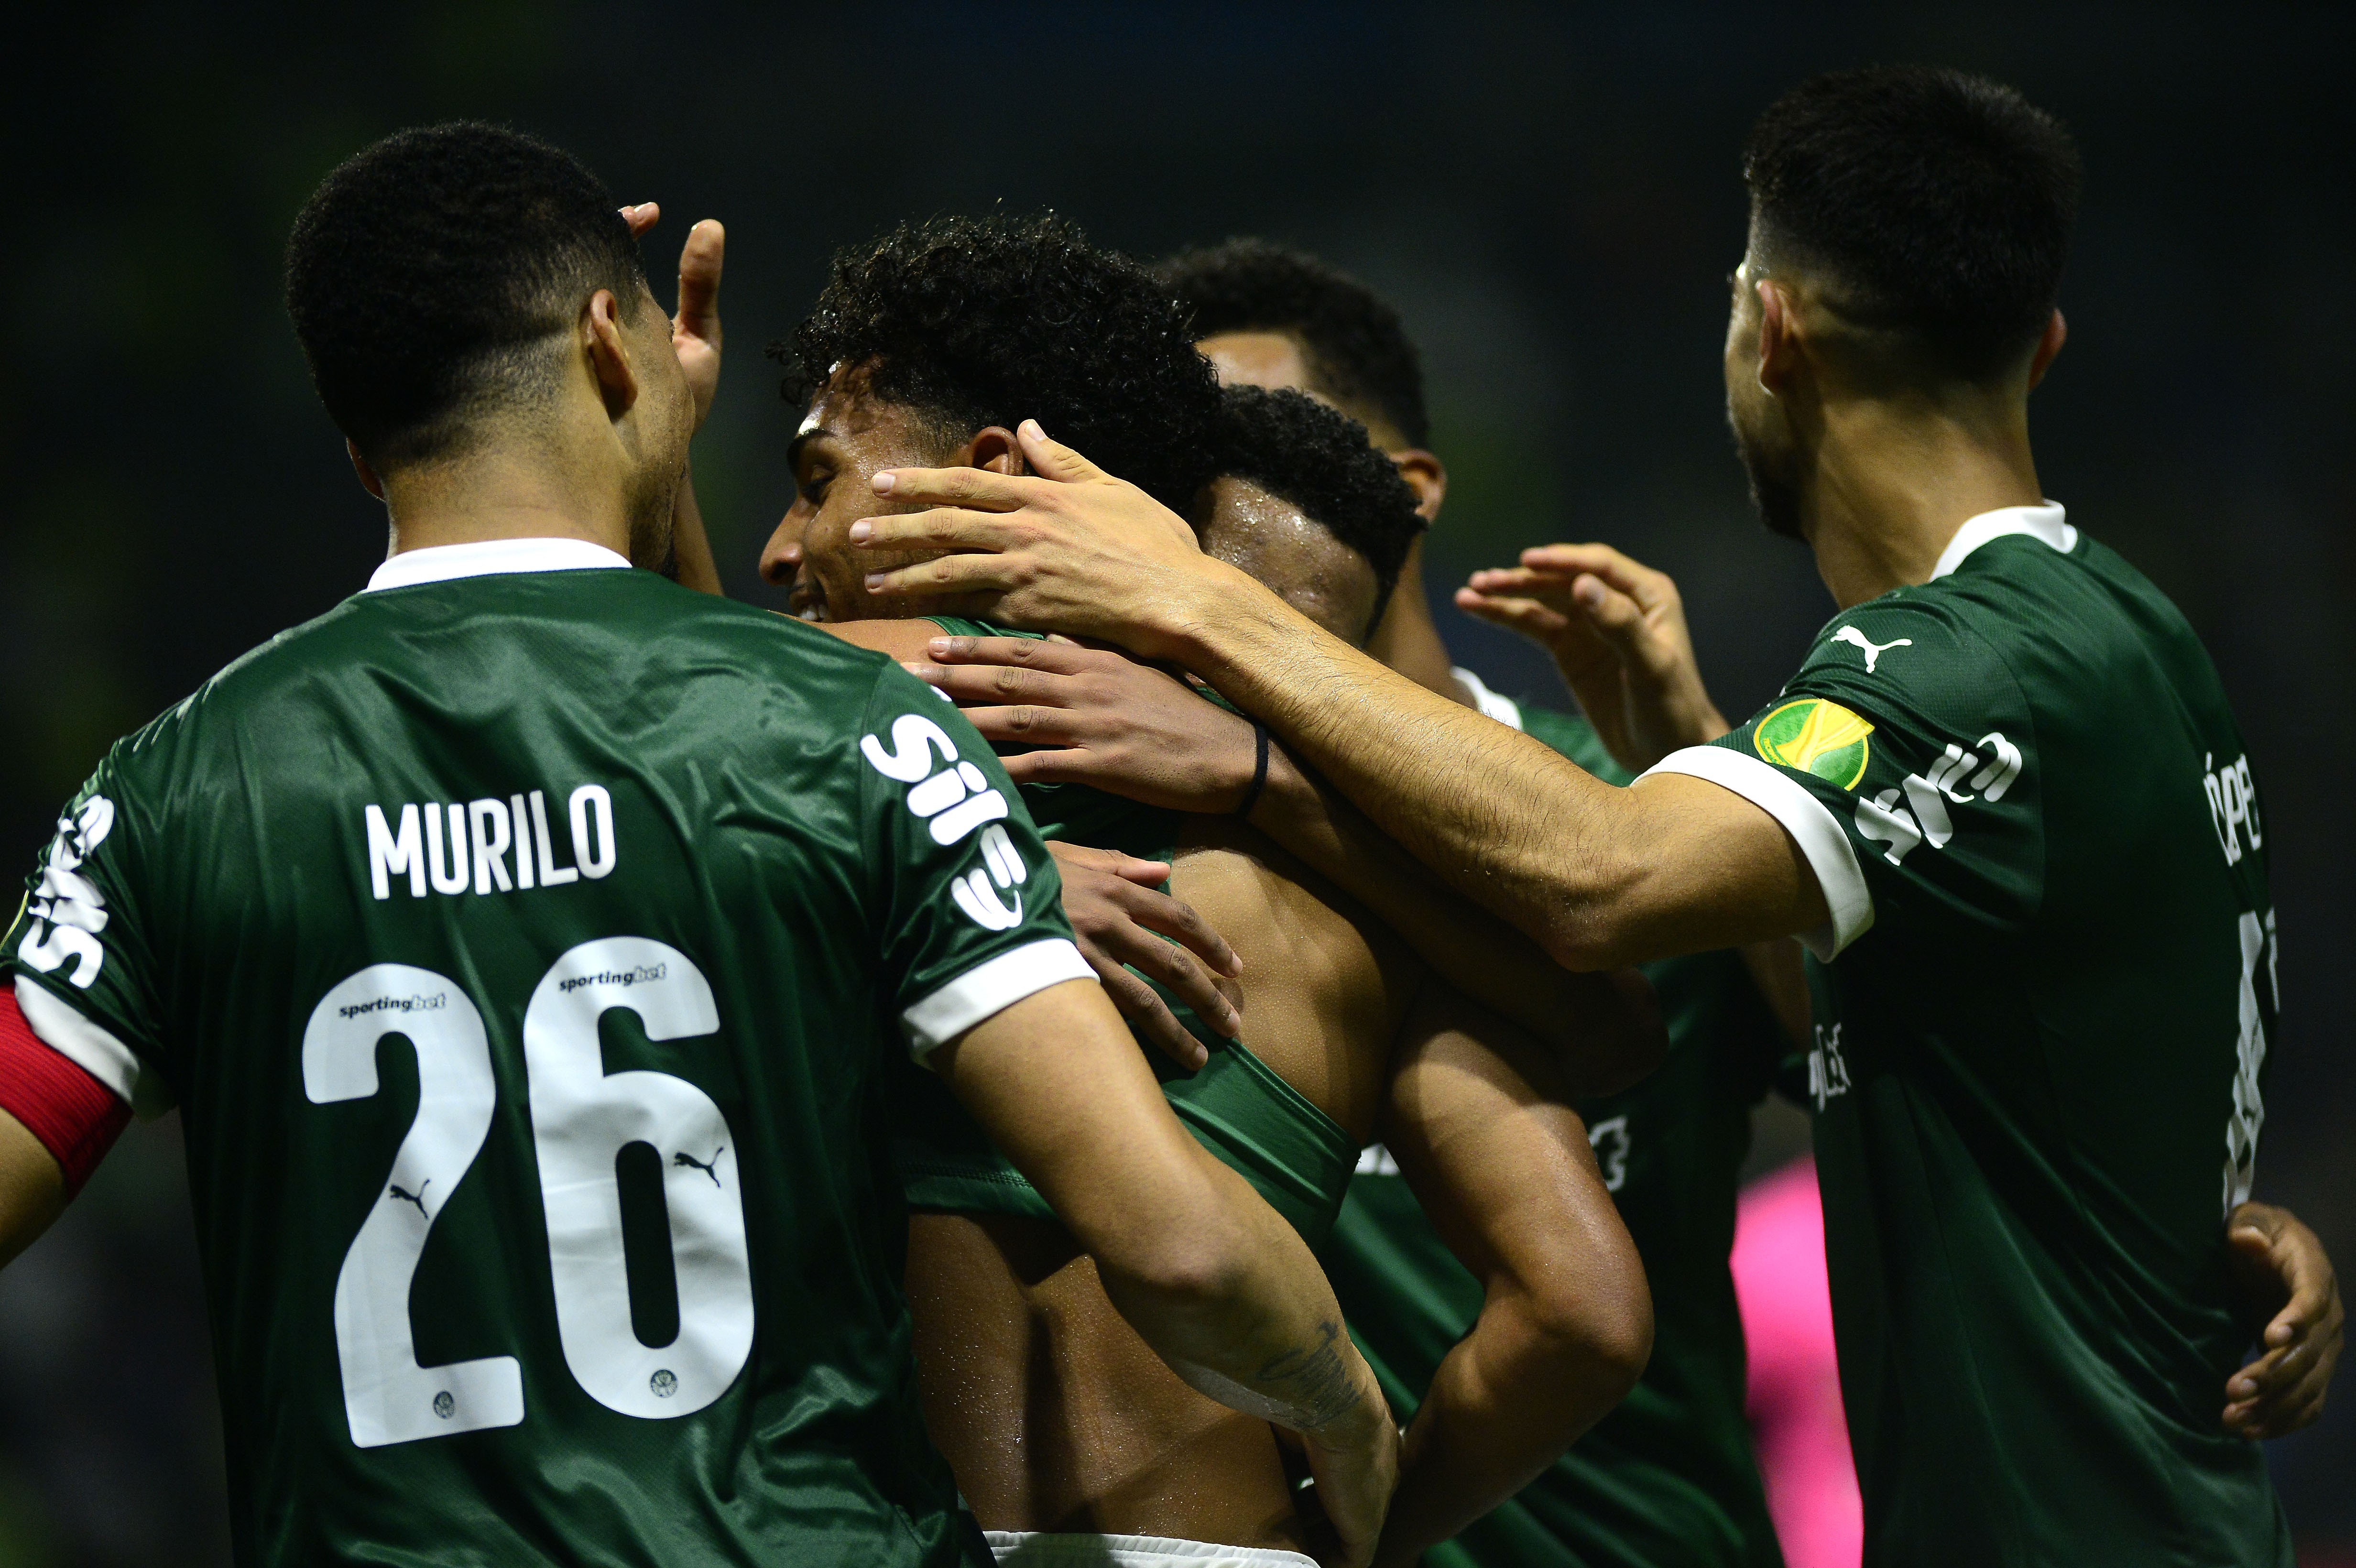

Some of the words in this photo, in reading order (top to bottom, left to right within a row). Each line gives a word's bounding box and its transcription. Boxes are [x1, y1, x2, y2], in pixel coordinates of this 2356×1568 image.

[365, 784, 616, 900] MURILO
[340, 993, 446, 1019] sportingbet
[560, 962, 667, 992] sportingbet
[302, 936, 754, 1448] 26
